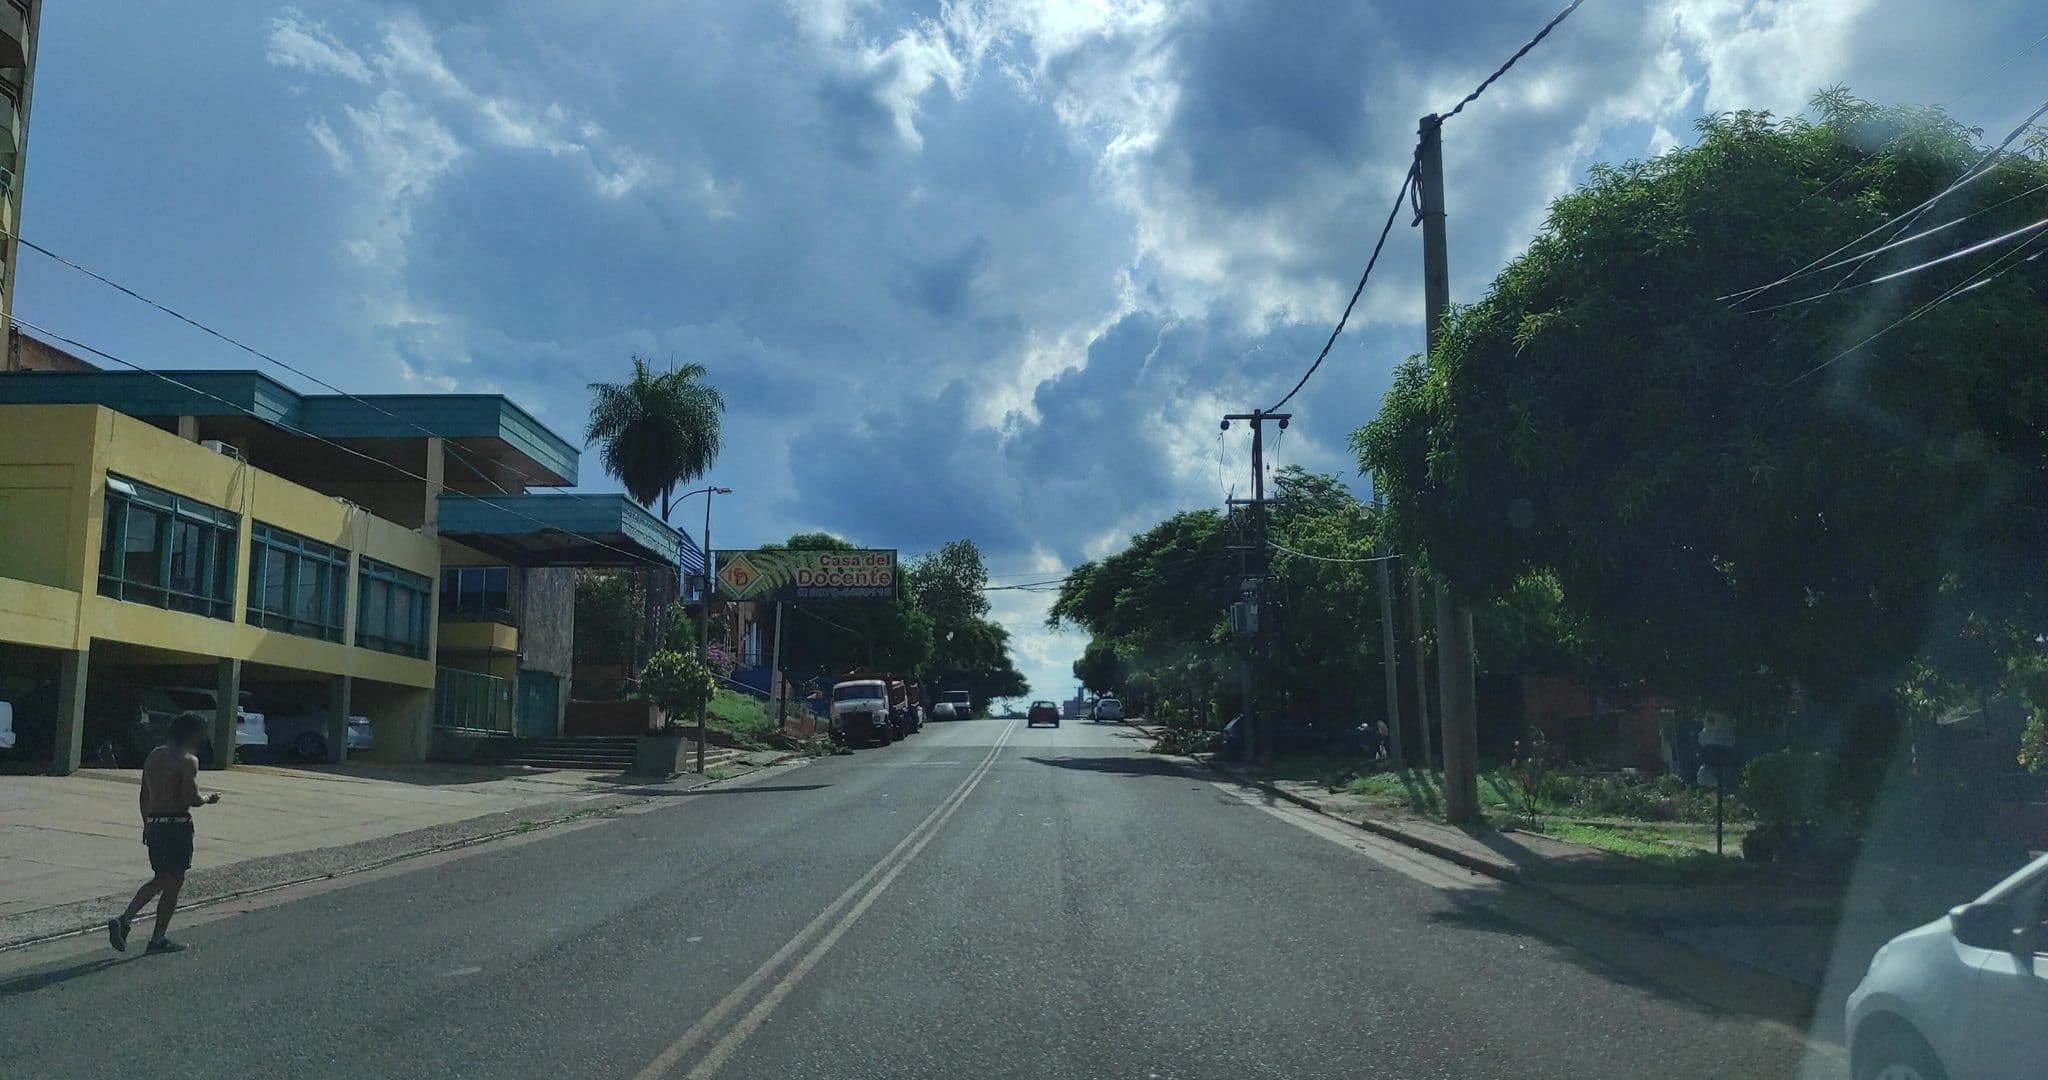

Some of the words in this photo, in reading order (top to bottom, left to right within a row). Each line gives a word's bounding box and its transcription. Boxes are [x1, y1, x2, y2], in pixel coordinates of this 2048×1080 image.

[819, 554, 860, 567] Casa
[864, 553, 890, 567] del
[798, 569, 891, 585] Docente
